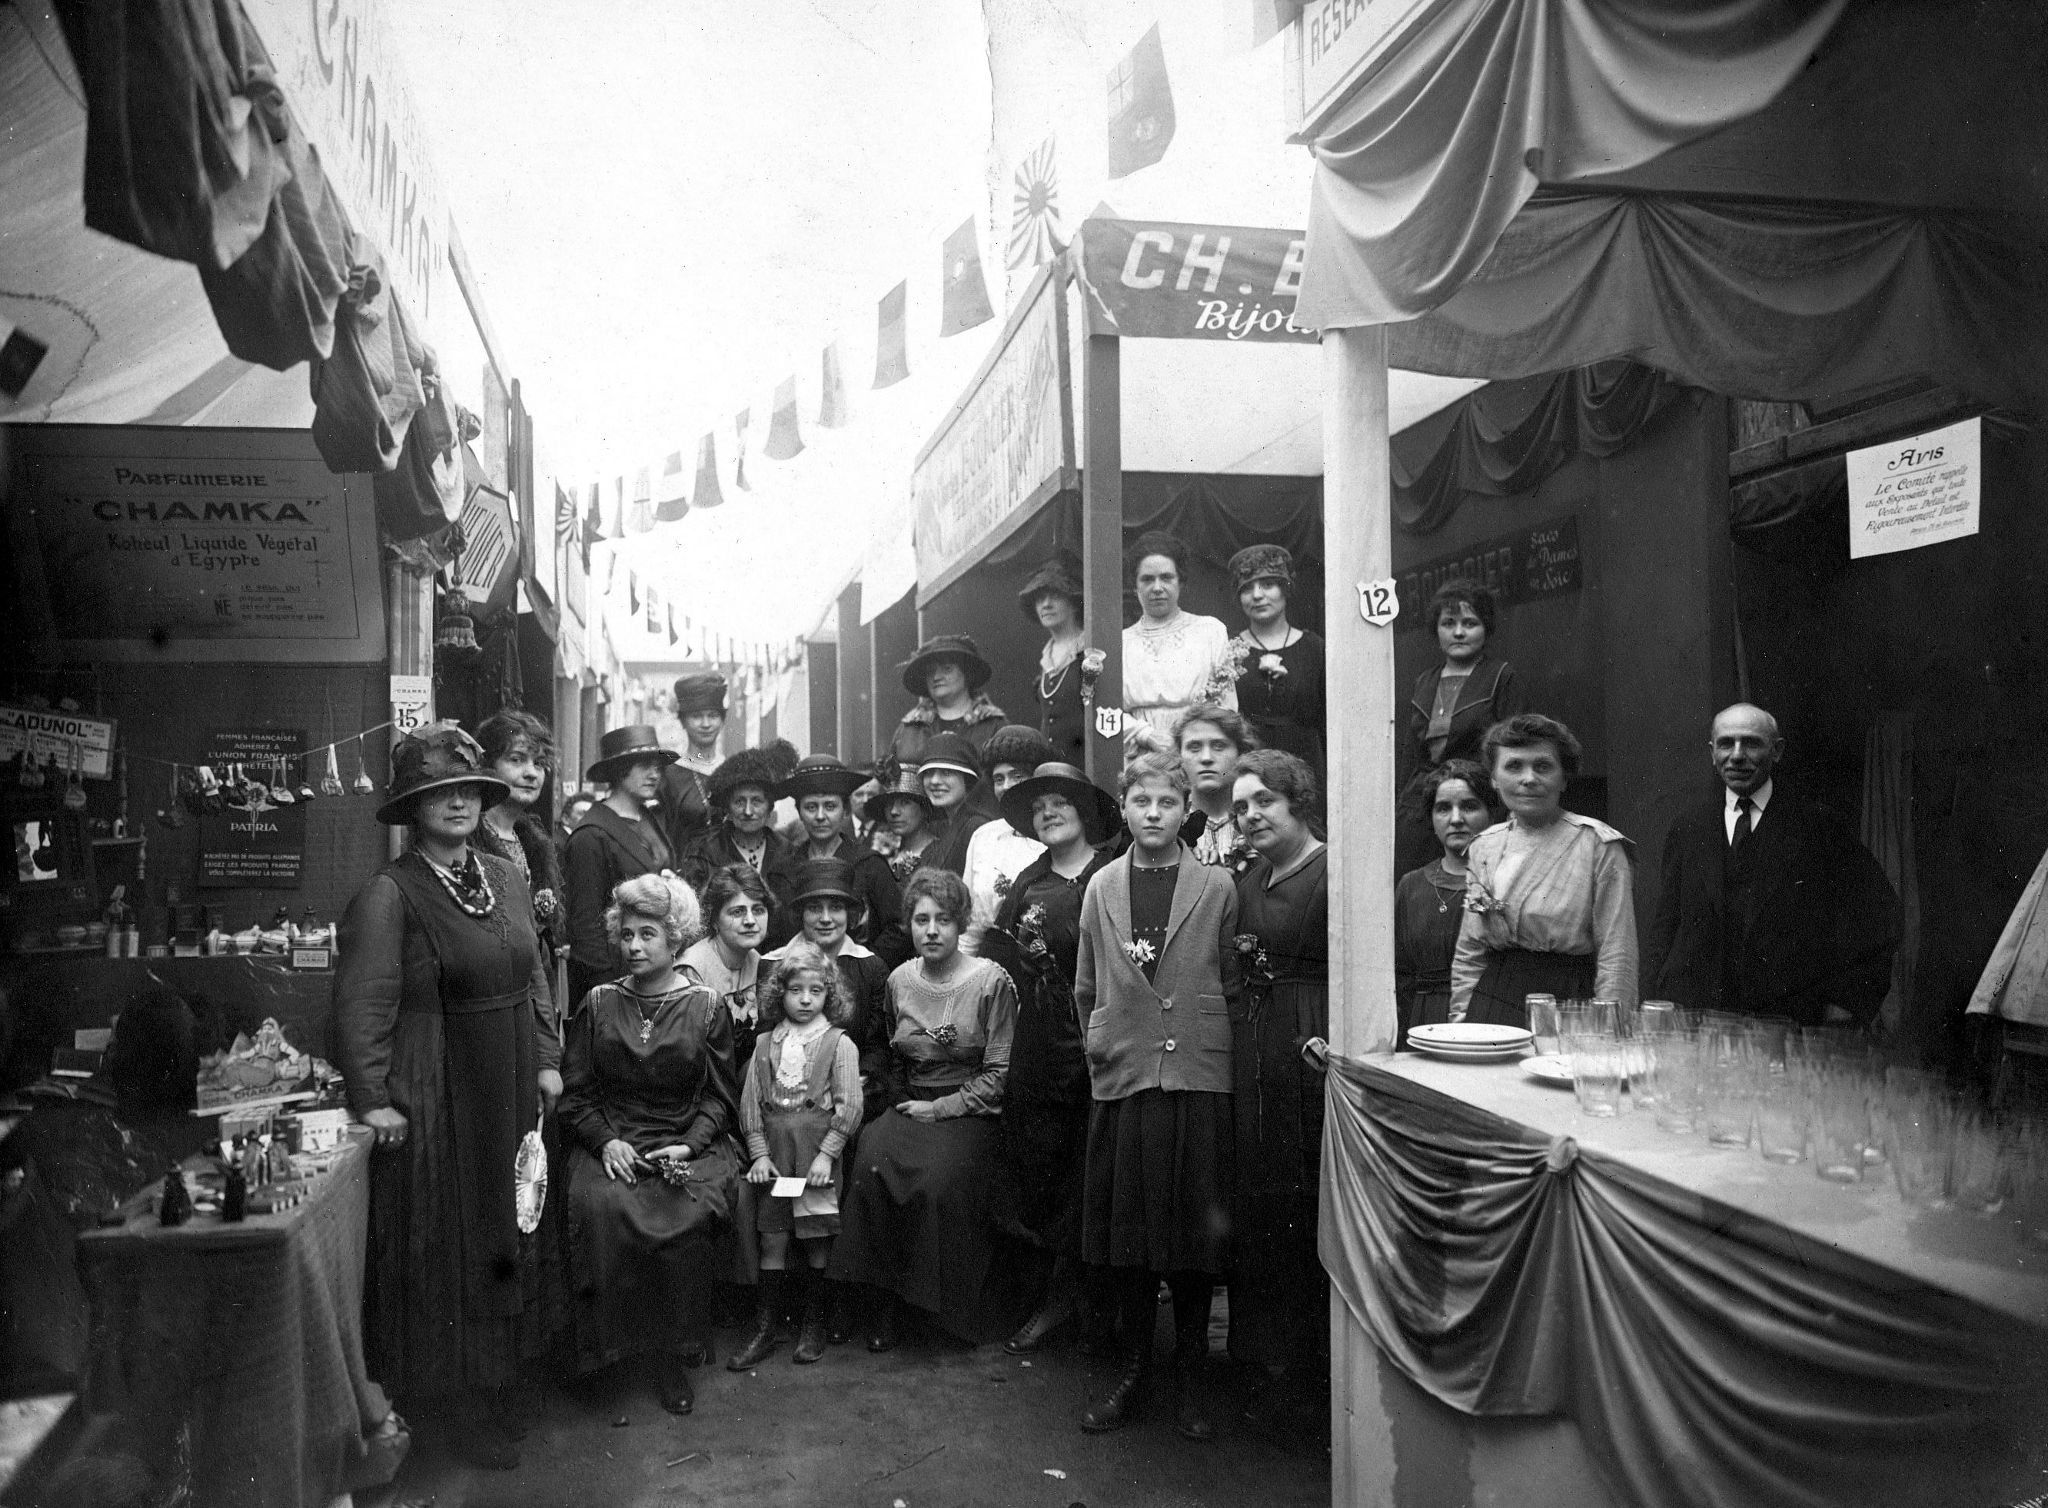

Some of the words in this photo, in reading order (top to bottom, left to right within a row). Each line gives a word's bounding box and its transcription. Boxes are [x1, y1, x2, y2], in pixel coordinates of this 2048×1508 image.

[1311, 0, 1375, 66] RESE
[1120, 230, 1252, 295] CH.
[1875, 483, 1892, 496] Le
[1897, 471, 1936, 490] Comité
[1865, 499, 1883, 508] aux
[1907, 503, 1918, 511] au
[180, 534, 247, 554] Liquide
[1362, 587, 1392, 617] 12
[398, 708, 418, 728] 15
[1100, 713, 1116, 731] 14
[230, 823, 278, 832] PATRIA
